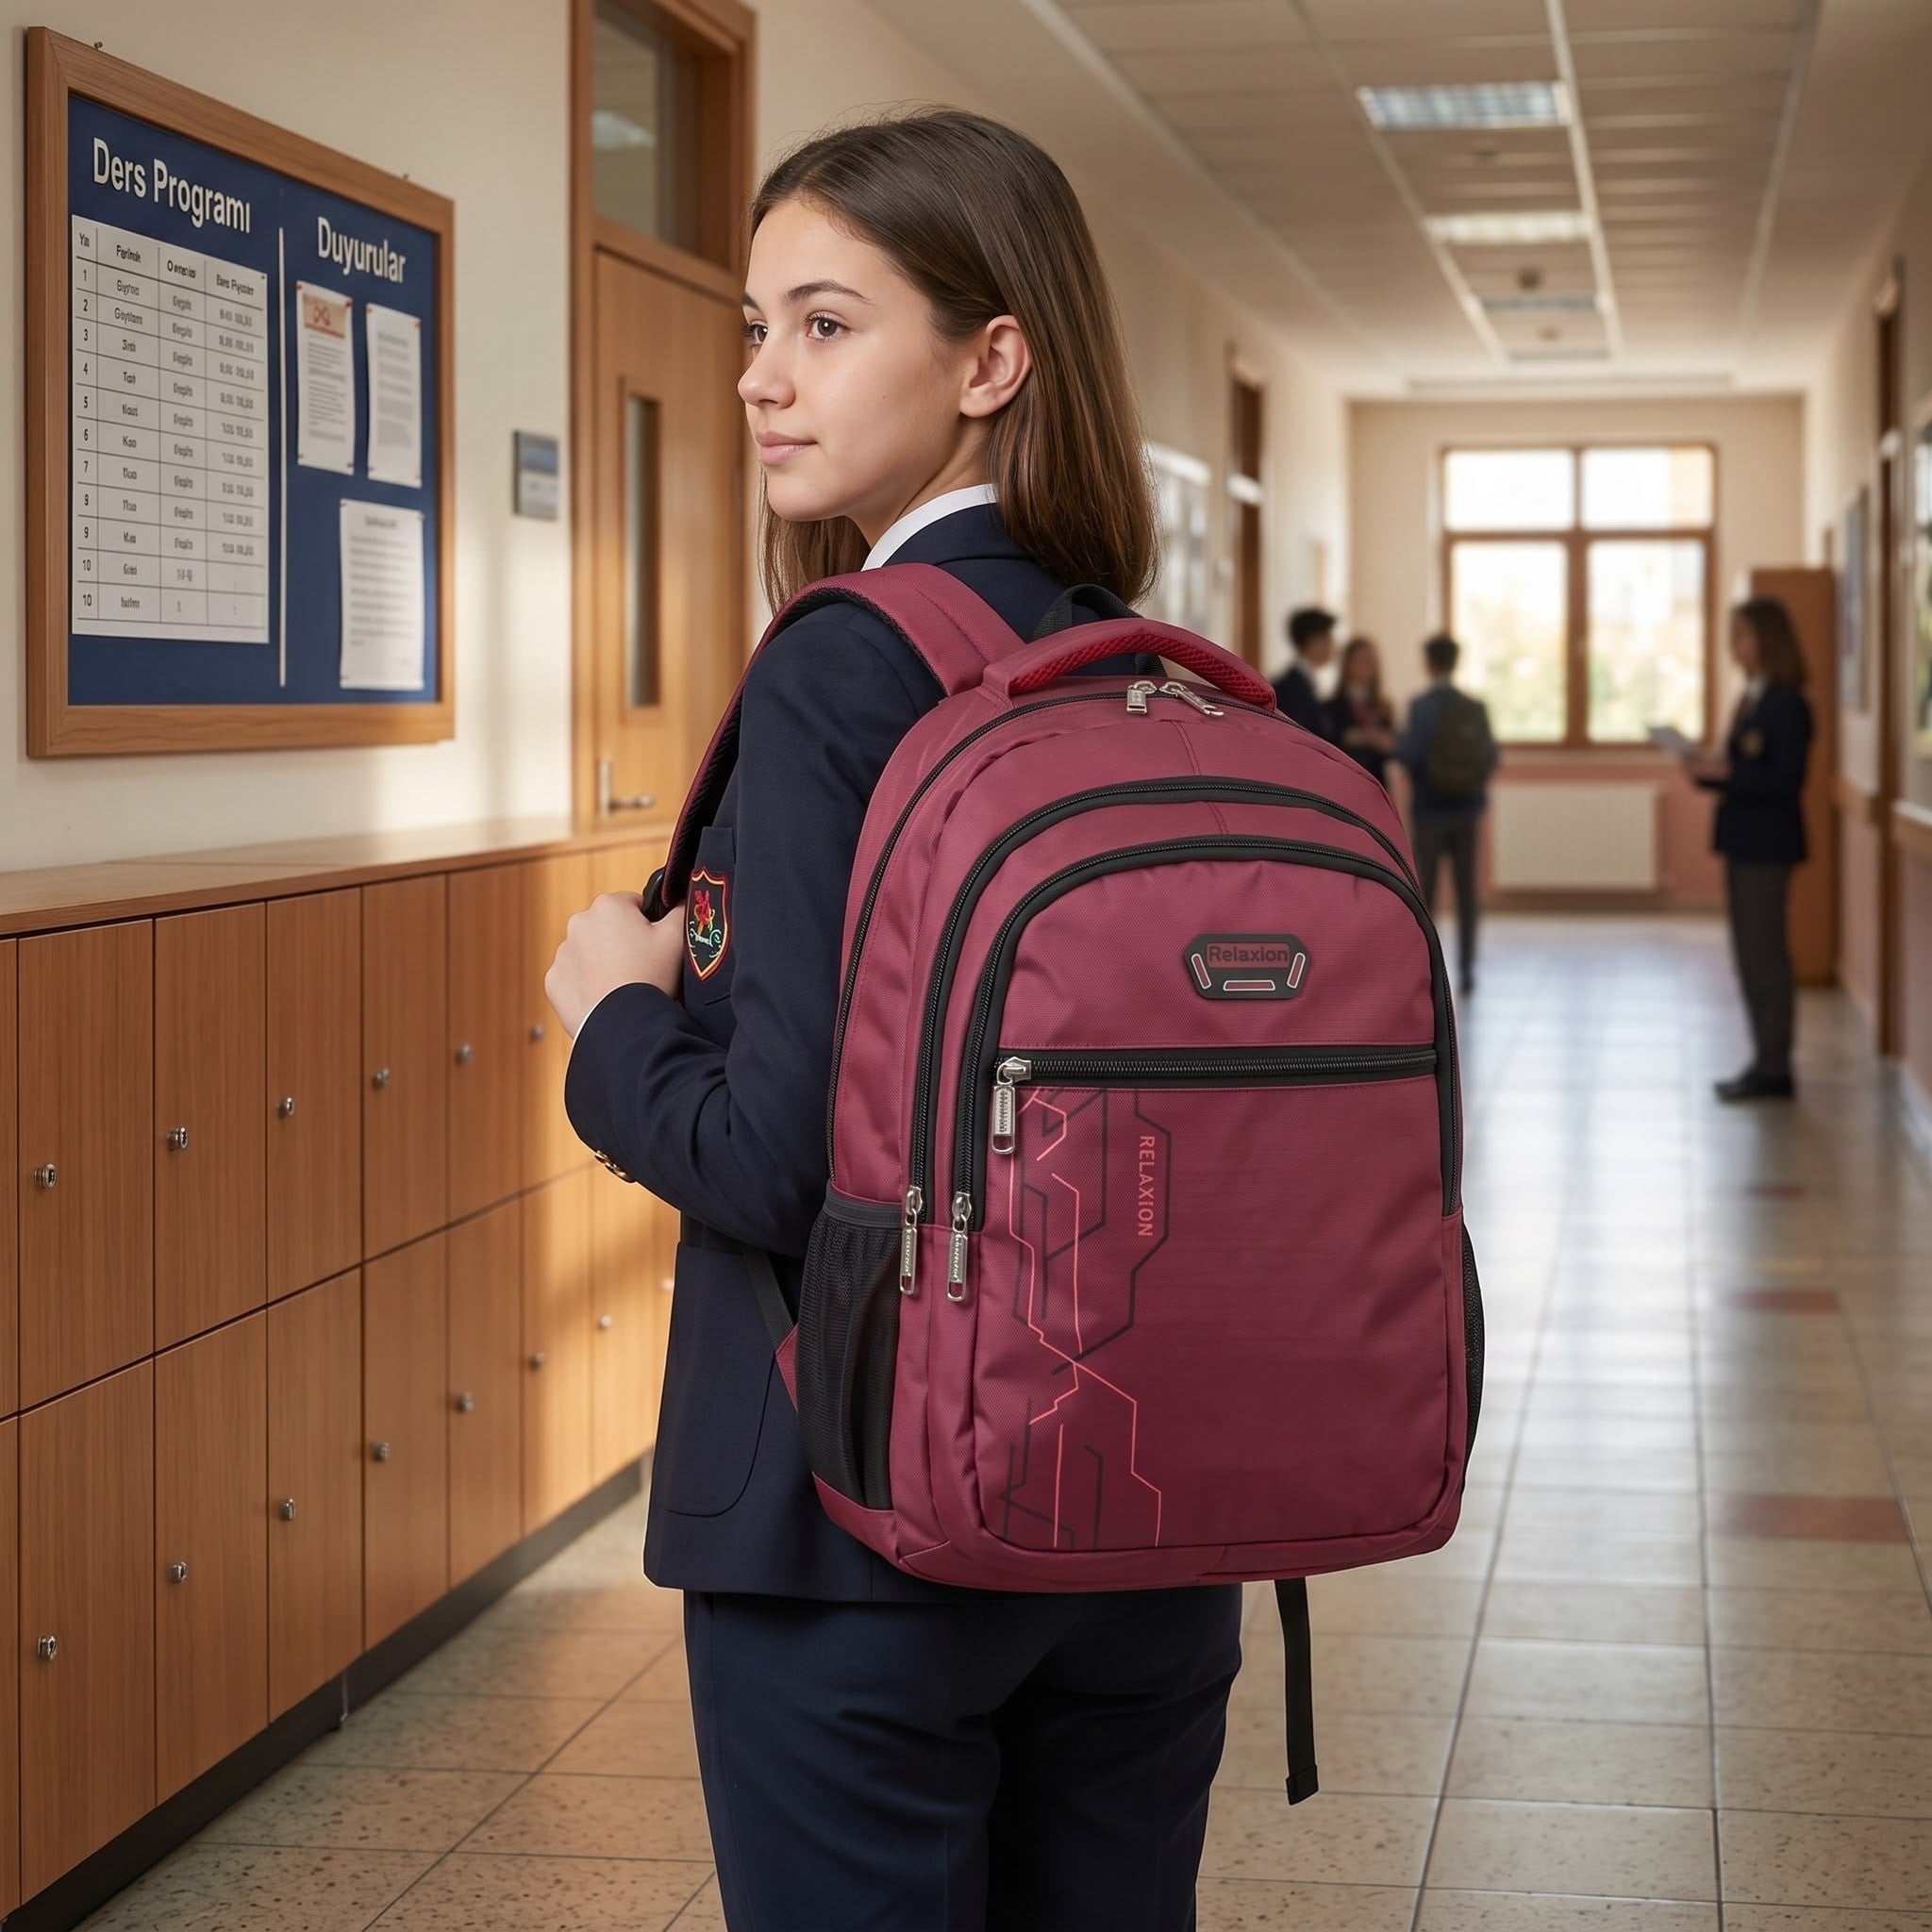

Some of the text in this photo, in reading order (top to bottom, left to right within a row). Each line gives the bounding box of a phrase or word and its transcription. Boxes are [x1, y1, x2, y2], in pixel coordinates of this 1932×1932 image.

[93, 137, 250, 233] Ders Programı
[317, 216, 406, 282] Duyurular
[82, 269, 88, 281] 1
[82, 299, 89, 311] 2
[83, 328, 90, 341] 3
[82, 362, 89, 375] 4
[82, 396, 89, 408] 5
[82, 428, 89, 441] 6
[82, 460, 90, 473] 7
[83, 526, 90, 539] 9
[82, 559, 92, 572] 10
[82, 593, 92, 607] 10
[1208, 946, 1288, 962] Relaxion
[1138, 1136, 1155, 1236] RELAXION
